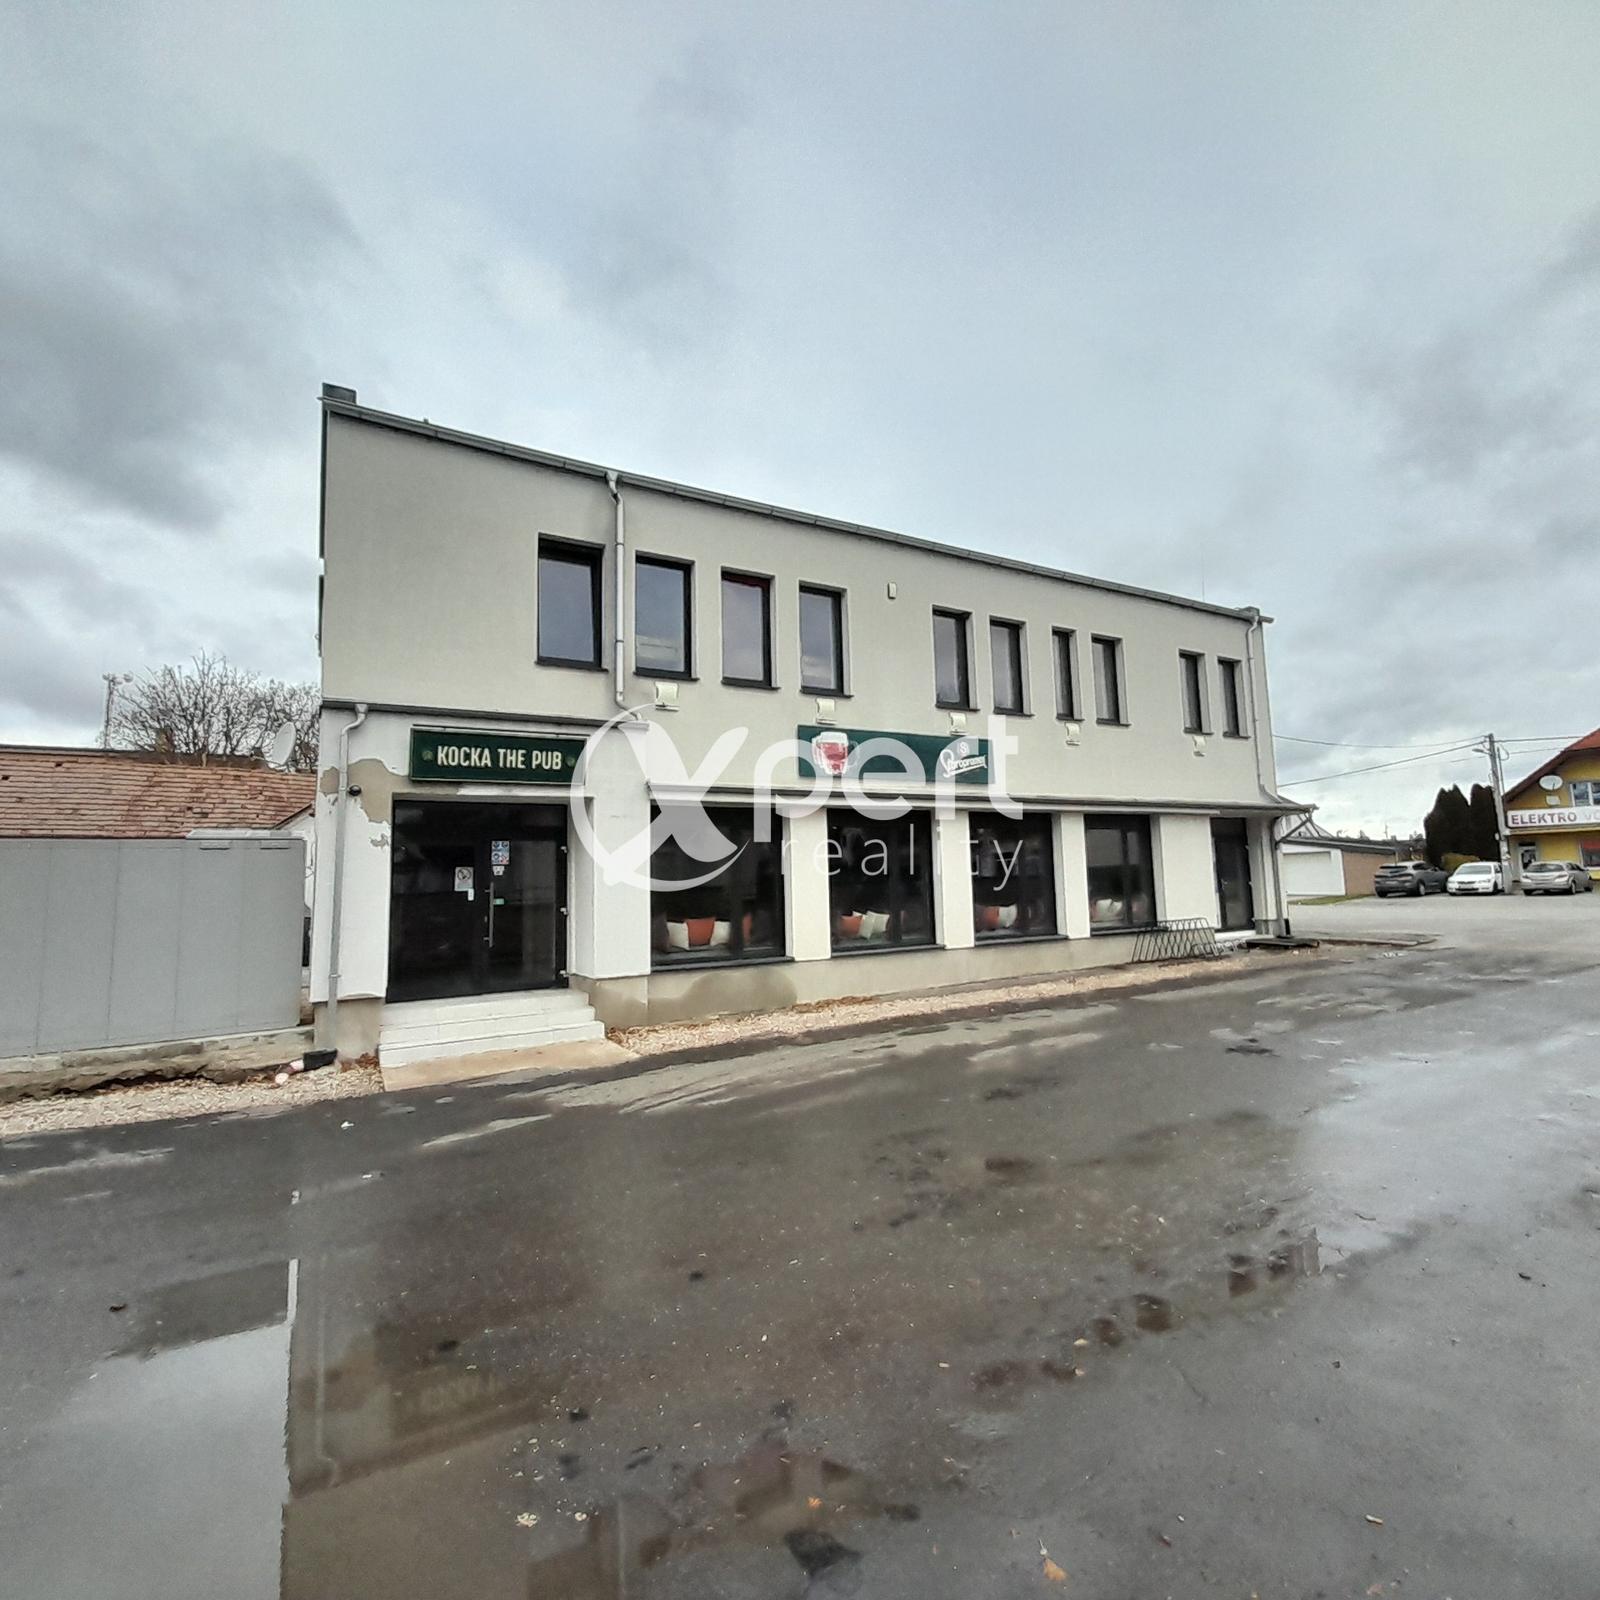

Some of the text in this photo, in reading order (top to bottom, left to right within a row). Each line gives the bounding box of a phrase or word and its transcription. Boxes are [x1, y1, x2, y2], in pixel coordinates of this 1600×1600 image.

[437, 745, 562, 770] KOCKA THE PUB
[1511, 812, 1577, 825] ELEKTRO
